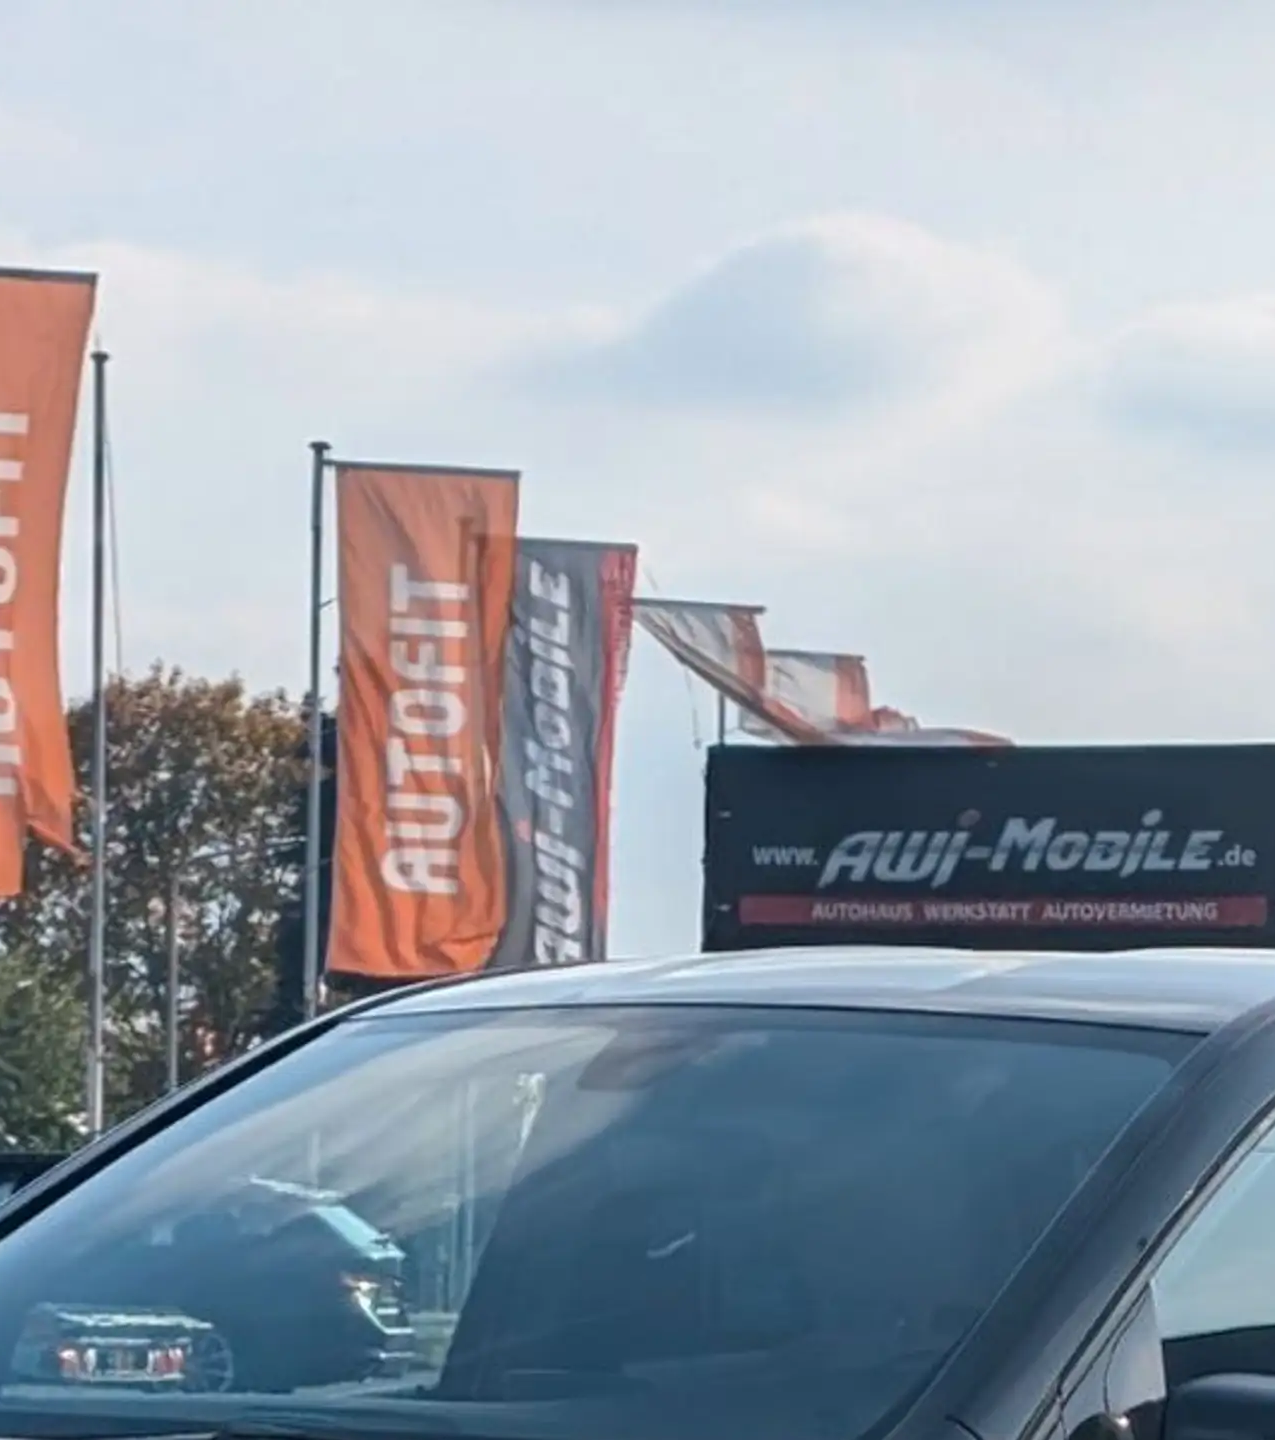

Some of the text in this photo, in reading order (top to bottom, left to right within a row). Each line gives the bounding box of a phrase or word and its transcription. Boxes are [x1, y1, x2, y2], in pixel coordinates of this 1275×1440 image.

[381, 563, 469, 893] AUTOFIT
[811, 901, 1217, 922] AUTOHAUS WERKSTATT AUTOVERMIETUNG
